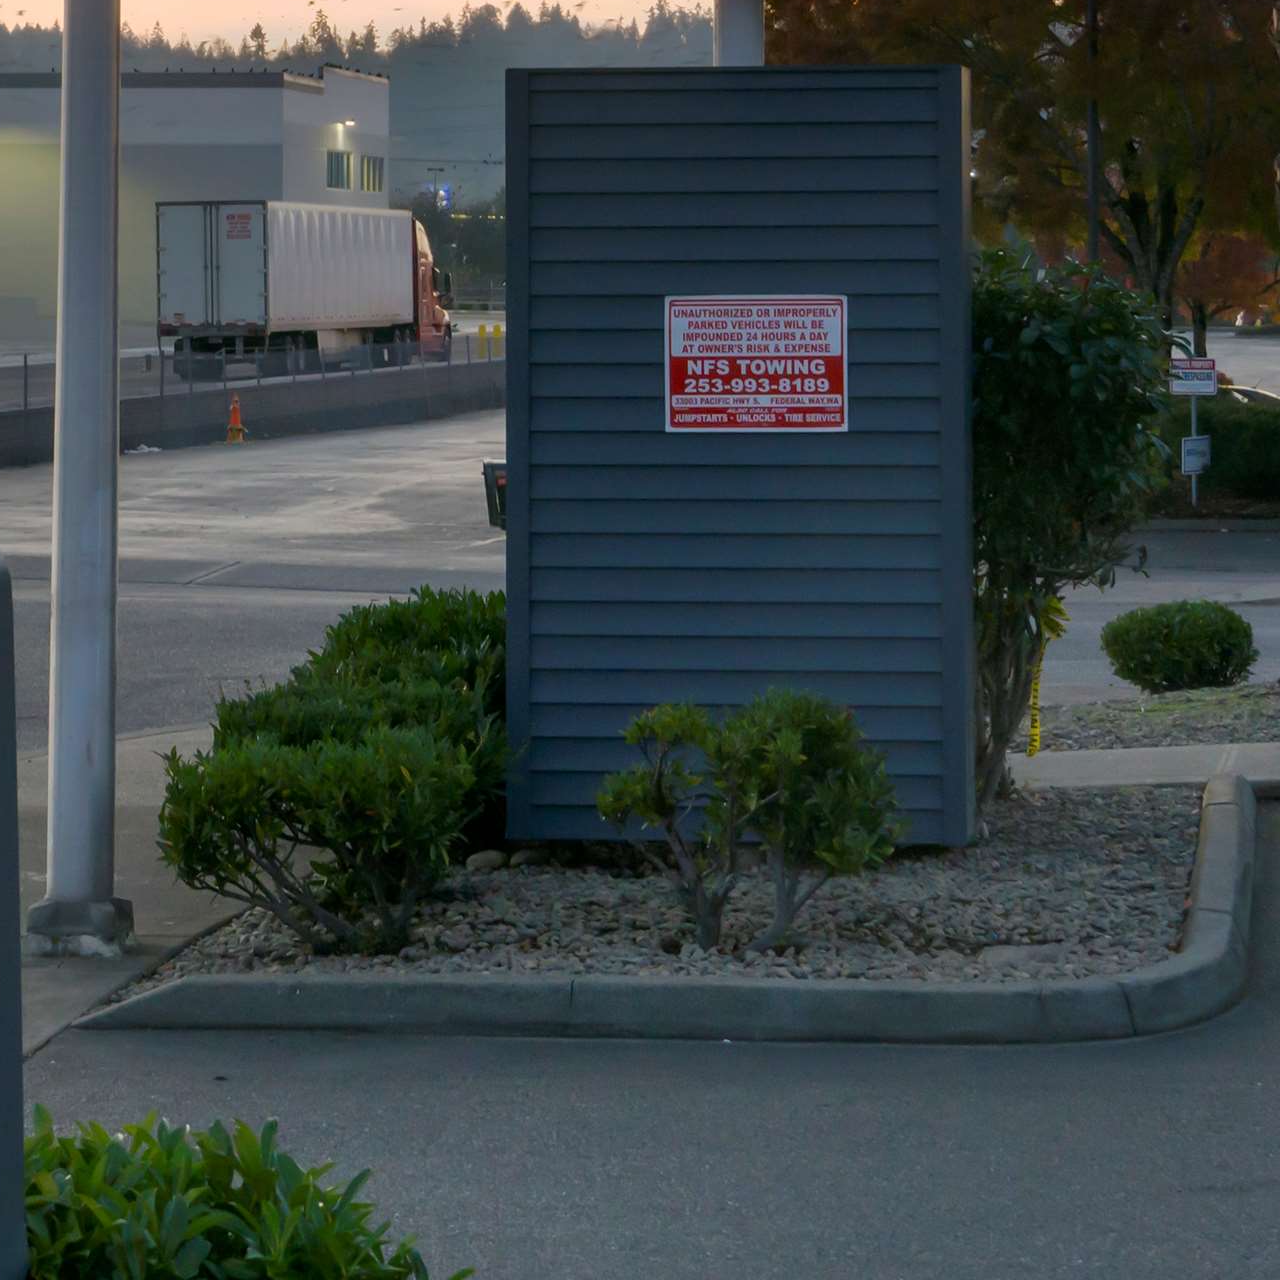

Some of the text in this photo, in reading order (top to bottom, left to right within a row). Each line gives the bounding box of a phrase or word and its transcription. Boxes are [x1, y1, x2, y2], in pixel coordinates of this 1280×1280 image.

[673, 308, 838, 318] UNAUTHORIZED OR IMPROPERLY
[687, 320, 825, 329] PARKED VEHICLES WILL BE
[682, 332, 829, 342] IMPOUNDED 24 HOURS A DAY
[681, 343, 831, 353] AT OWNER'S RISK & EXPENSE
[687, 359, 826, 376] NFS TOWING
[684, 377, 830, 393] 253-993-8189
[700, 397, 731, 406] PACIFIC
[732, 397, 751, 406] HWY
[770, 396, 806, 405] FEDERAL
[674, 413, 840, 423] JUMPSTARTS UNLOCKS TIRE SERVICE
